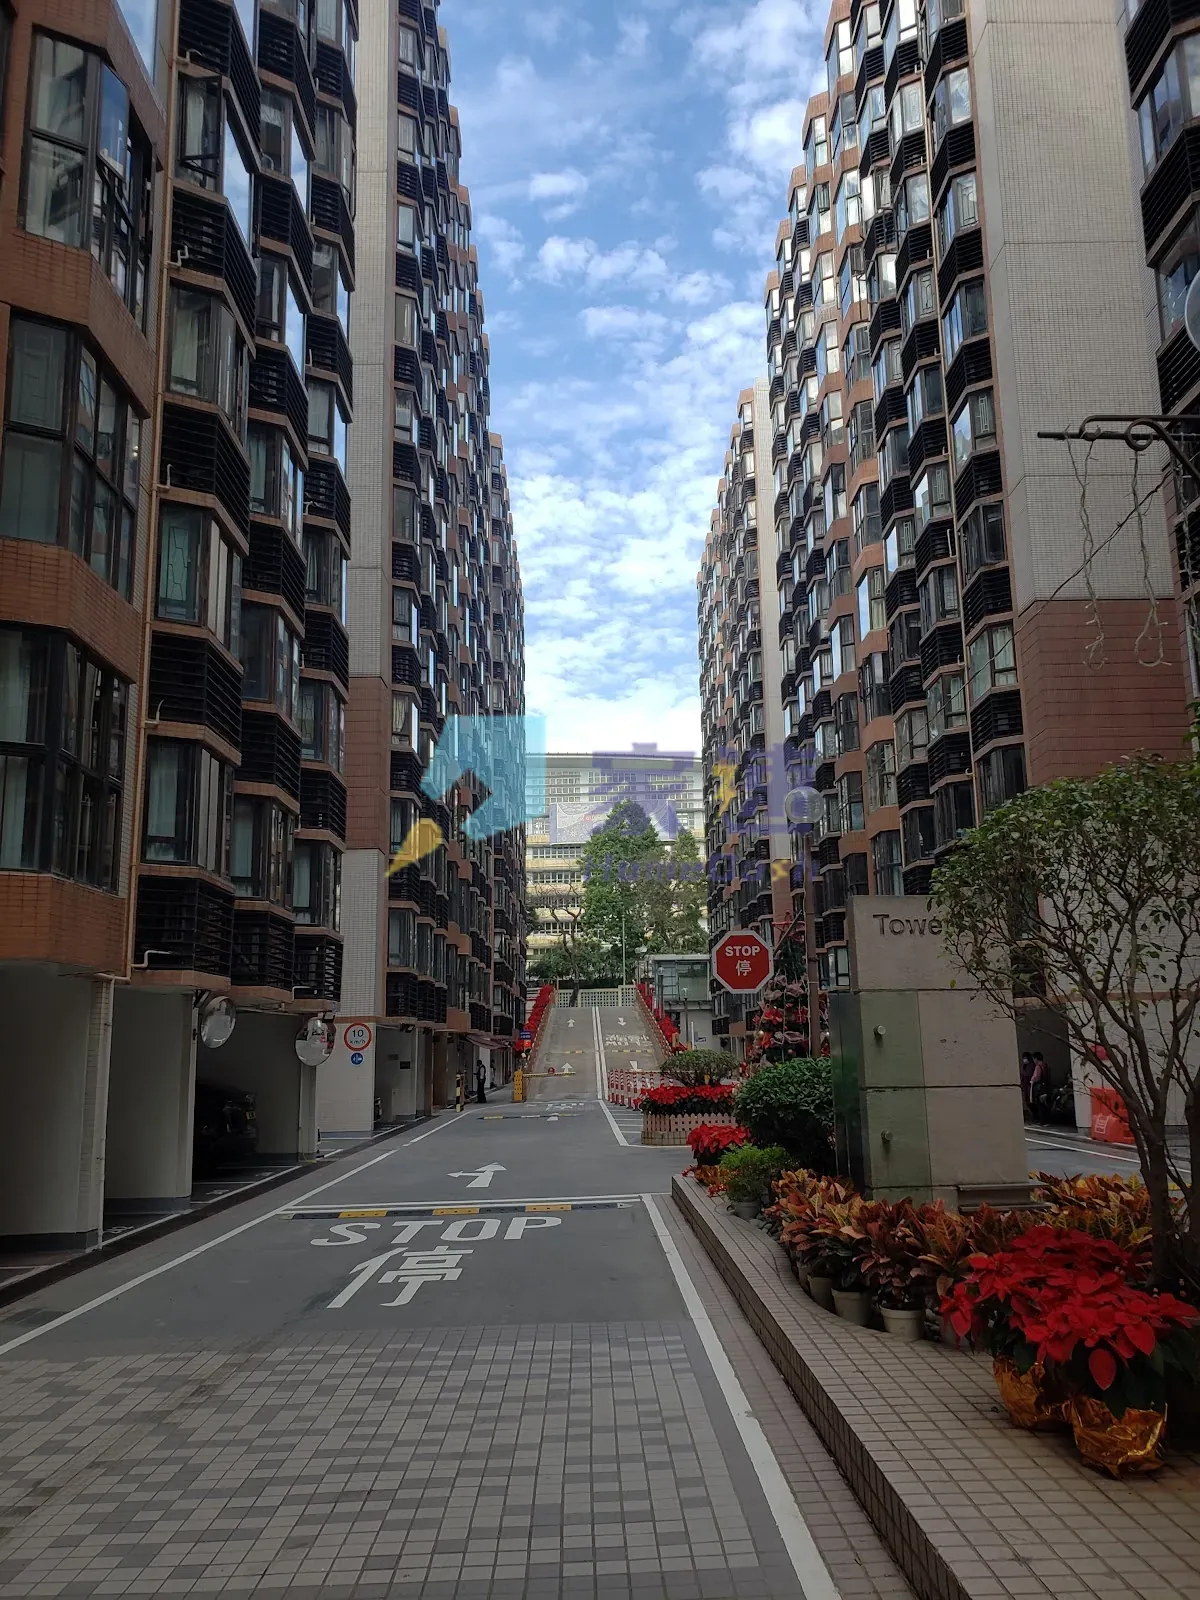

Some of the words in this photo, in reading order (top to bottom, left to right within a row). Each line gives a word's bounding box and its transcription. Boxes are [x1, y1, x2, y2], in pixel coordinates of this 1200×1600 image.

[873, 913, 946, 935] Towe
[725, 946, 760, 956] STOP
[736, 960, 751, 976] 停
[352, 1029, 364, 1038] 10
[310, 1217, 562, 1246] STOP
[326, 1245, 474, 1309] 停
